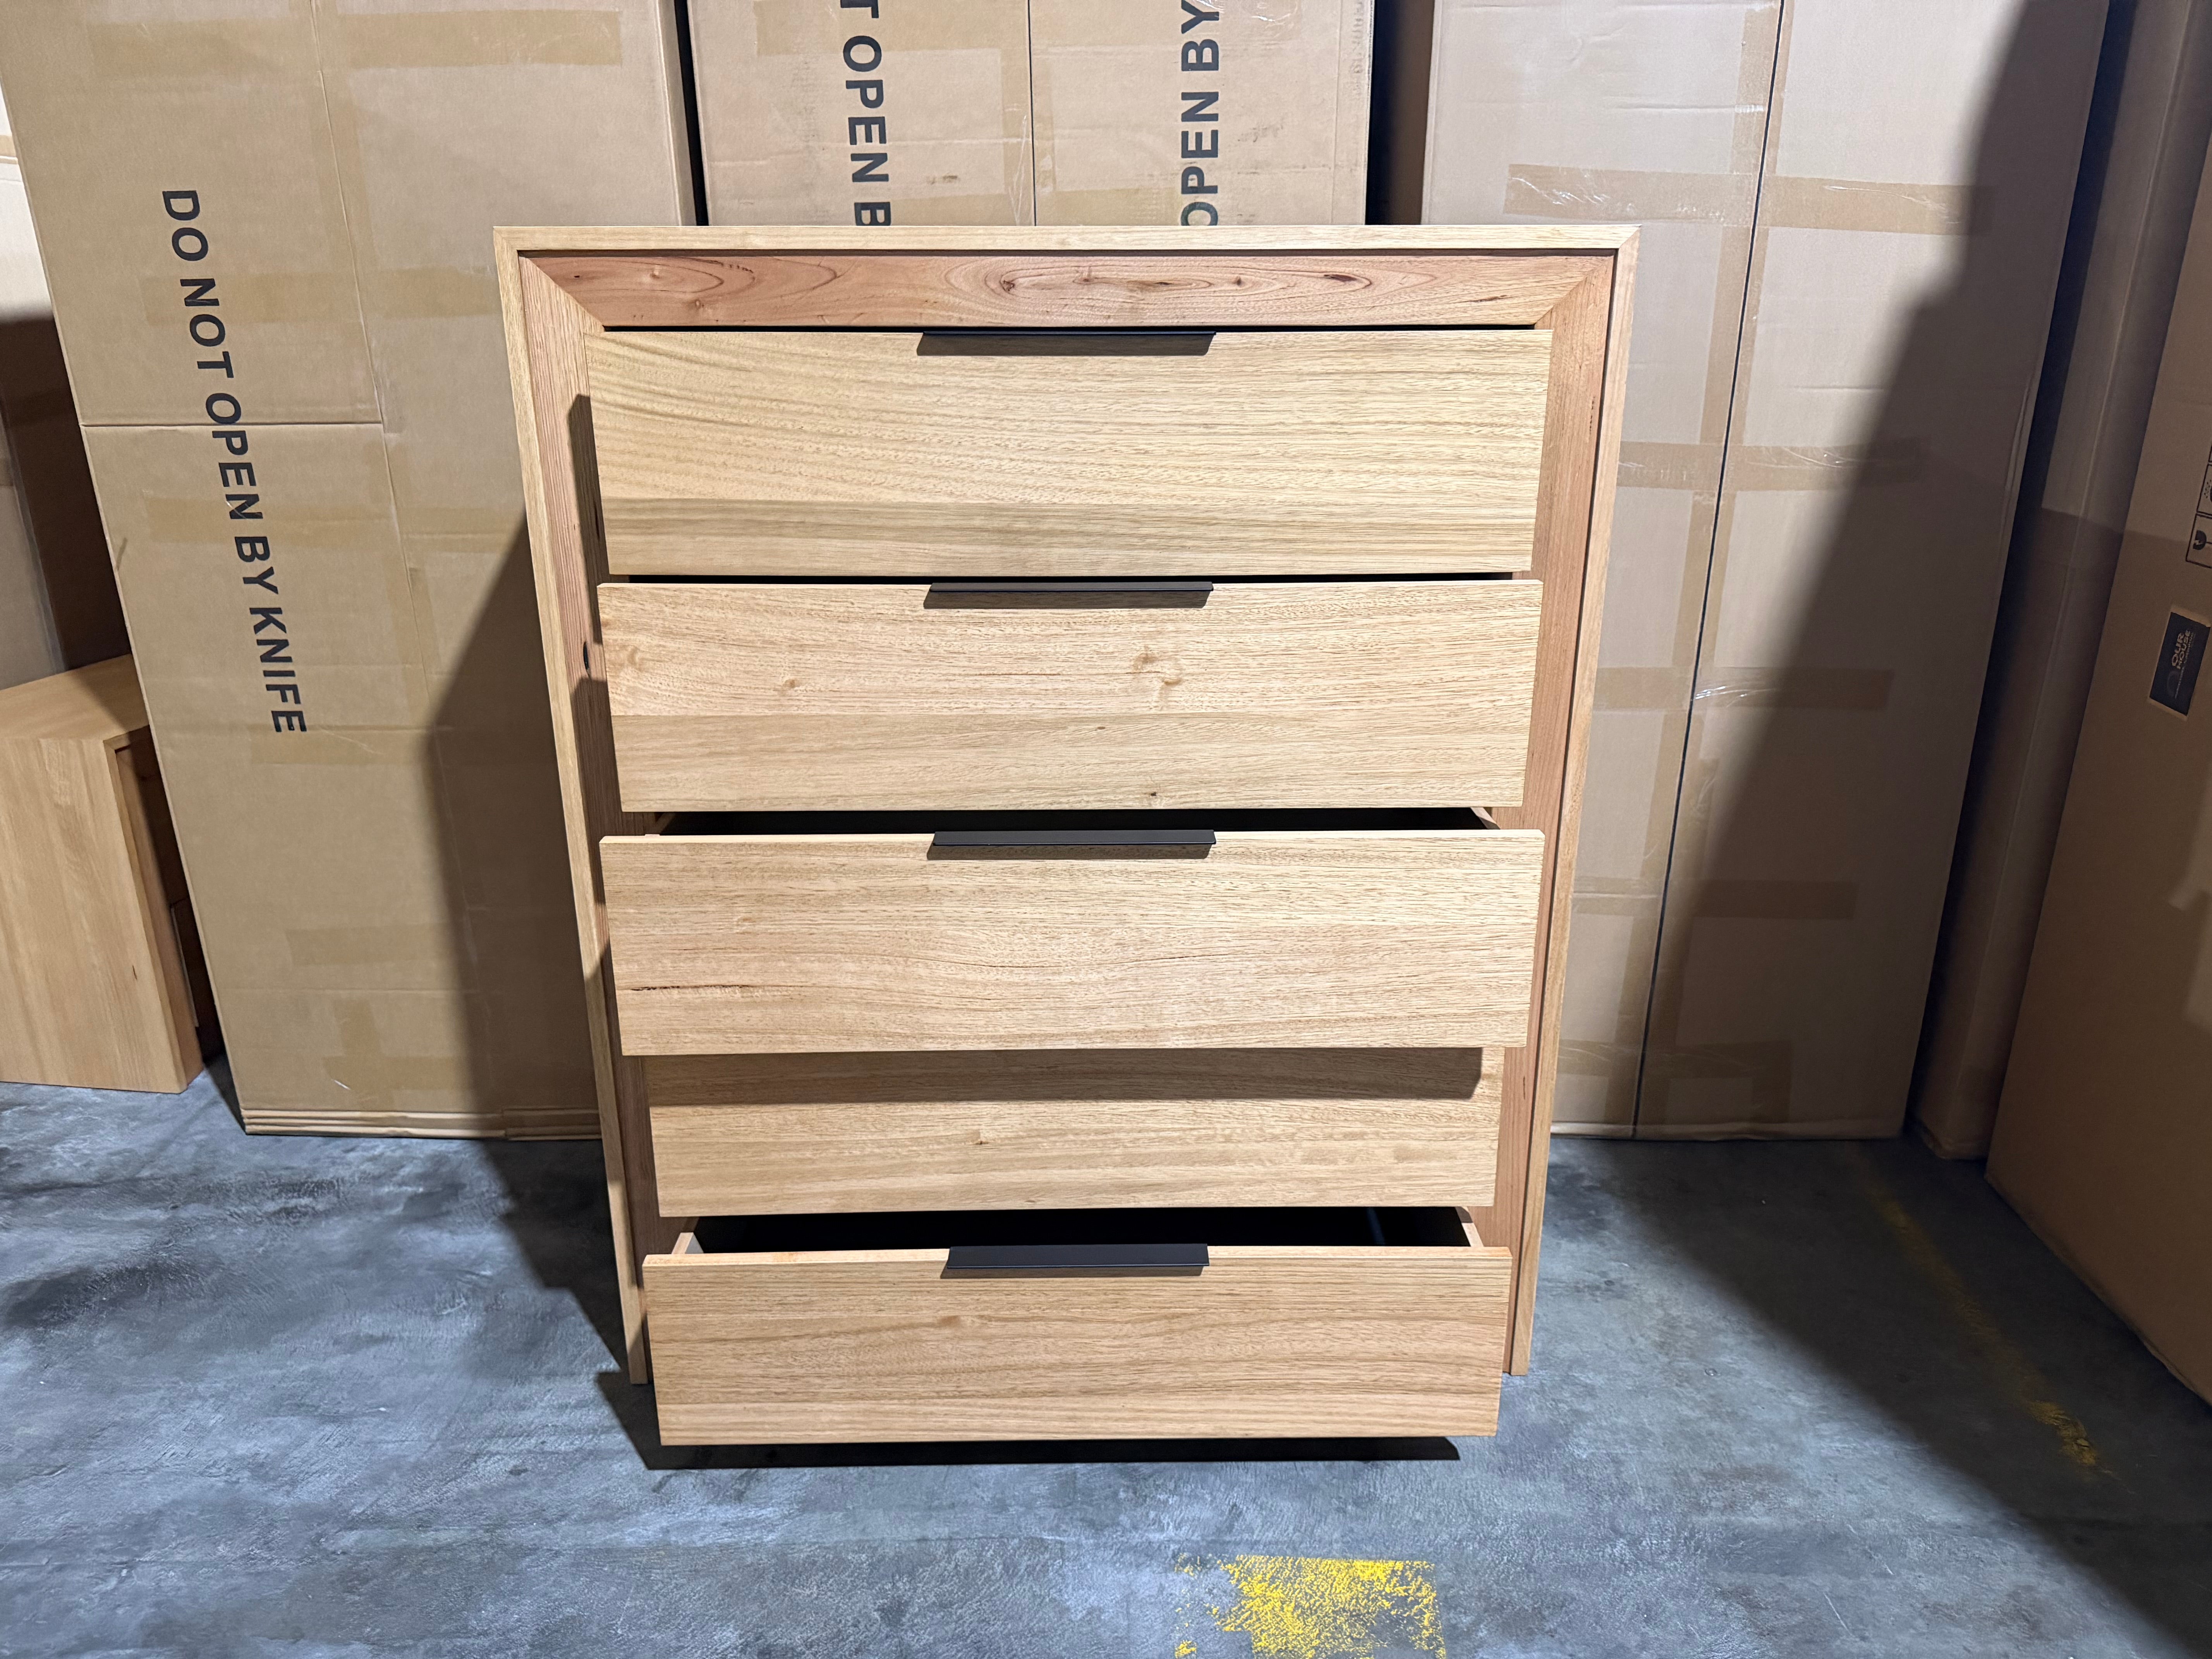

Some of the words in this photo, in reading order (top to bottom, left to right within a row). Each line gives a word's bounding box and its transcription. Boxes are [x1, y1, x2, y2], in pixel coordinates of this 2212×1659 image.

[1181, 0, 1219, 71] BY
[843, 35, 889, 182] OPEN
[1180, 92, 1219, 226] OPEN
[162, 190, 208, 261] DO
[180, 278, 234, 378] NOT
[205, 393, 263, 519] OPEN
[234, 536, 278, 594] BY
[249, 607, 307, 733] KNIFE
[2171, 632, 2184, 666] OUR
[2176, 630, 2191, 669] HOUSE
